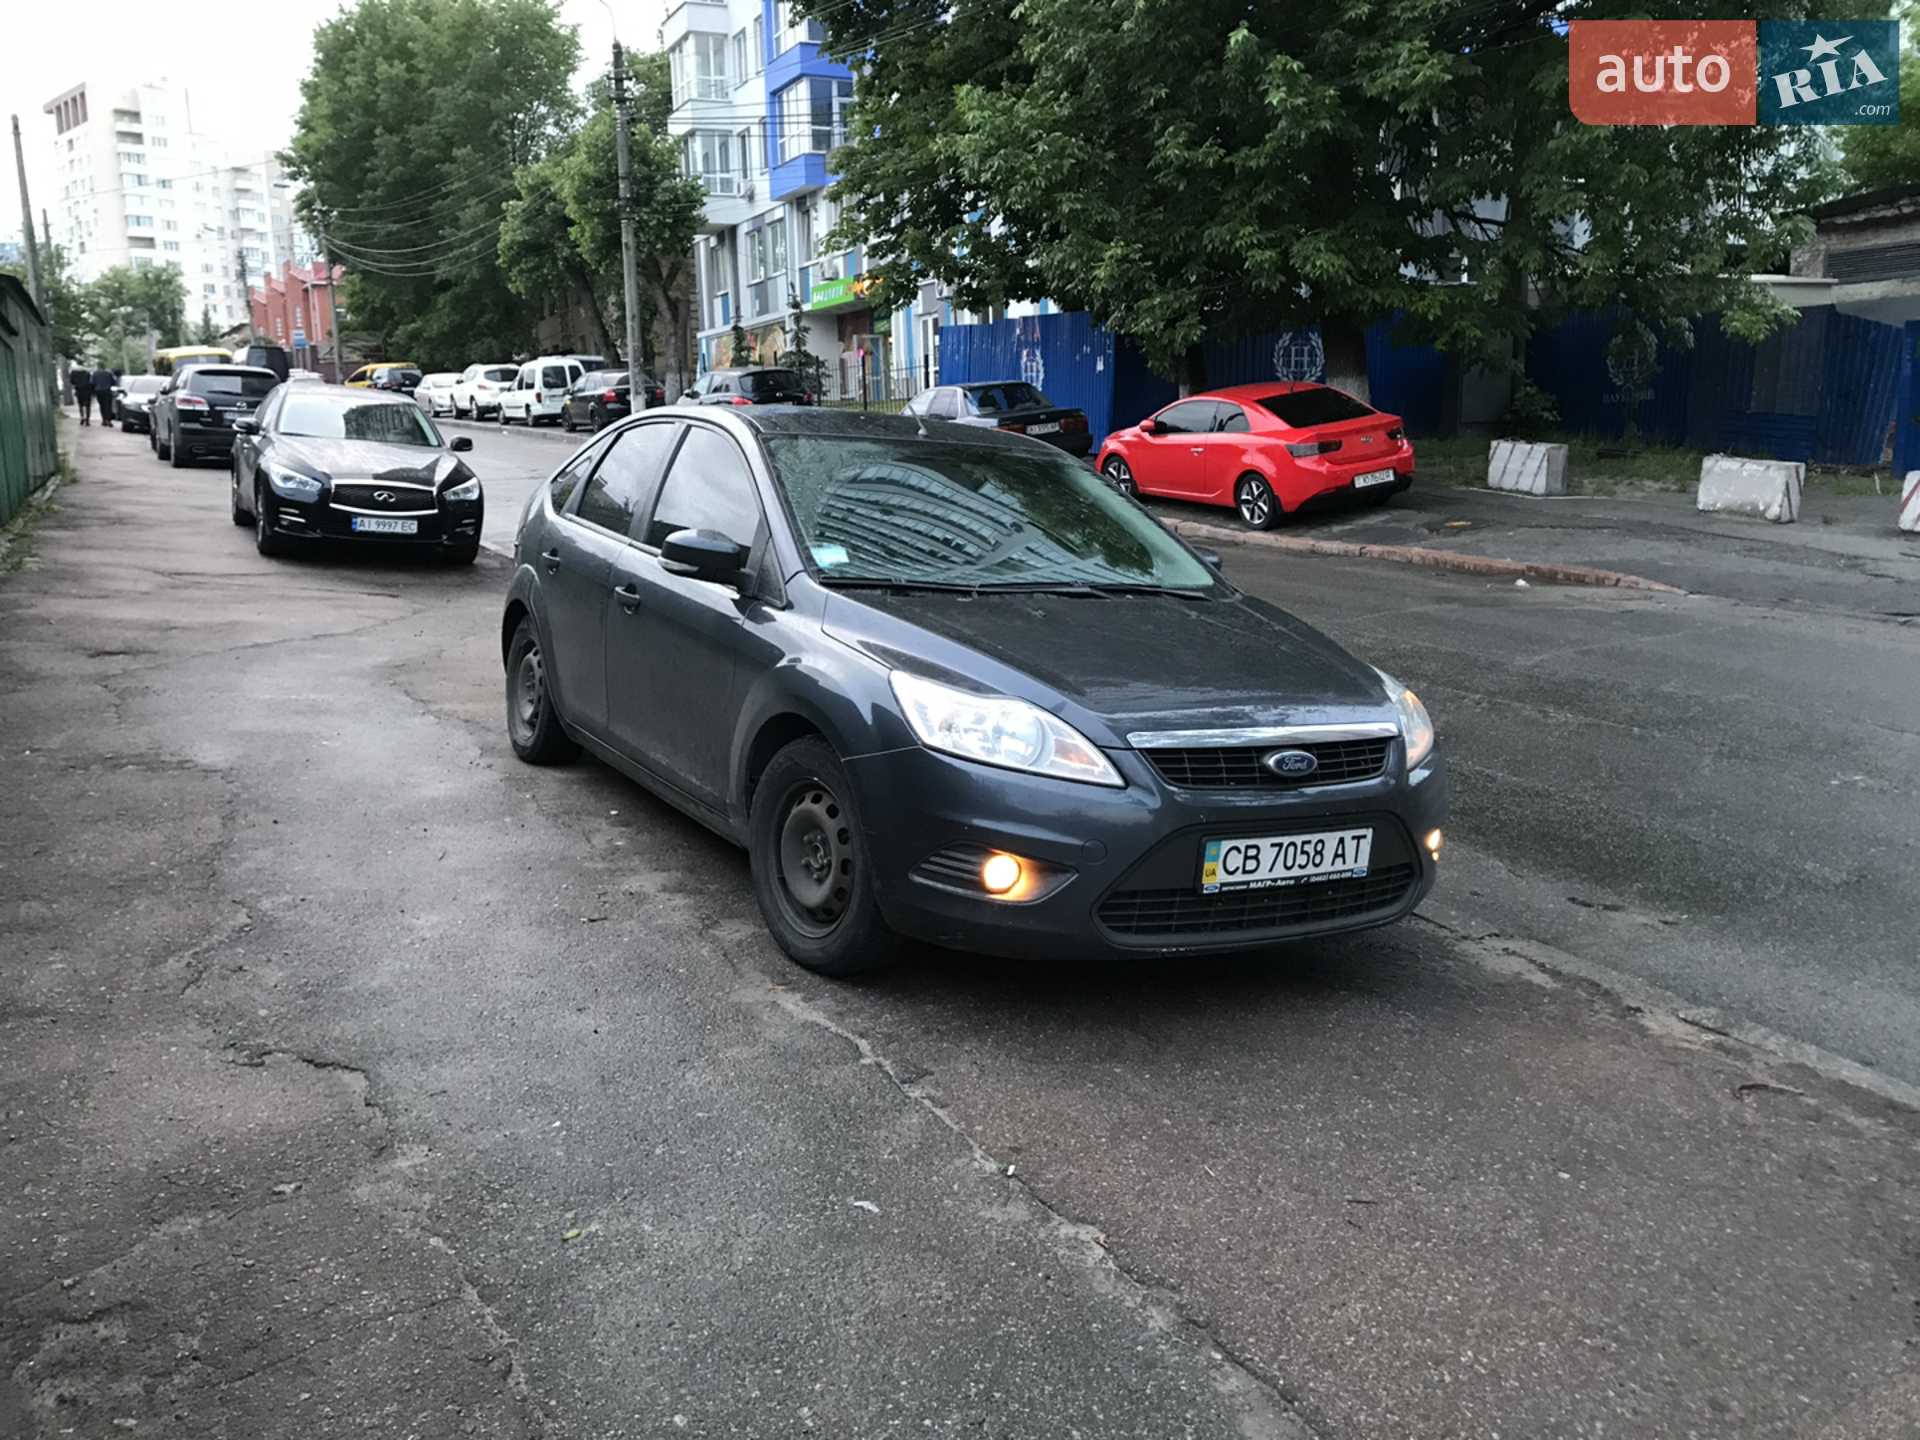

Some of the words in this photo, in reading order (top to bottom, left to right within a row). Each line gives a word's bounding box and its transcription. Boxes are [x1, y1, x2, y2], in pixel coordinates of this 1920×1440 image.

[358, 519, 372, 529] AI
[375, 520, 399, 531] 9997
[401, 521, 416, 532] EC
[1282, 756, 1308, 770] Ford
[1222, 844, 1261, 876] CB
[1268, 838, 1325, 873] 7058
[1331, 834, 1368, 866] AT
[1204, 868, 1217, 878] UA
